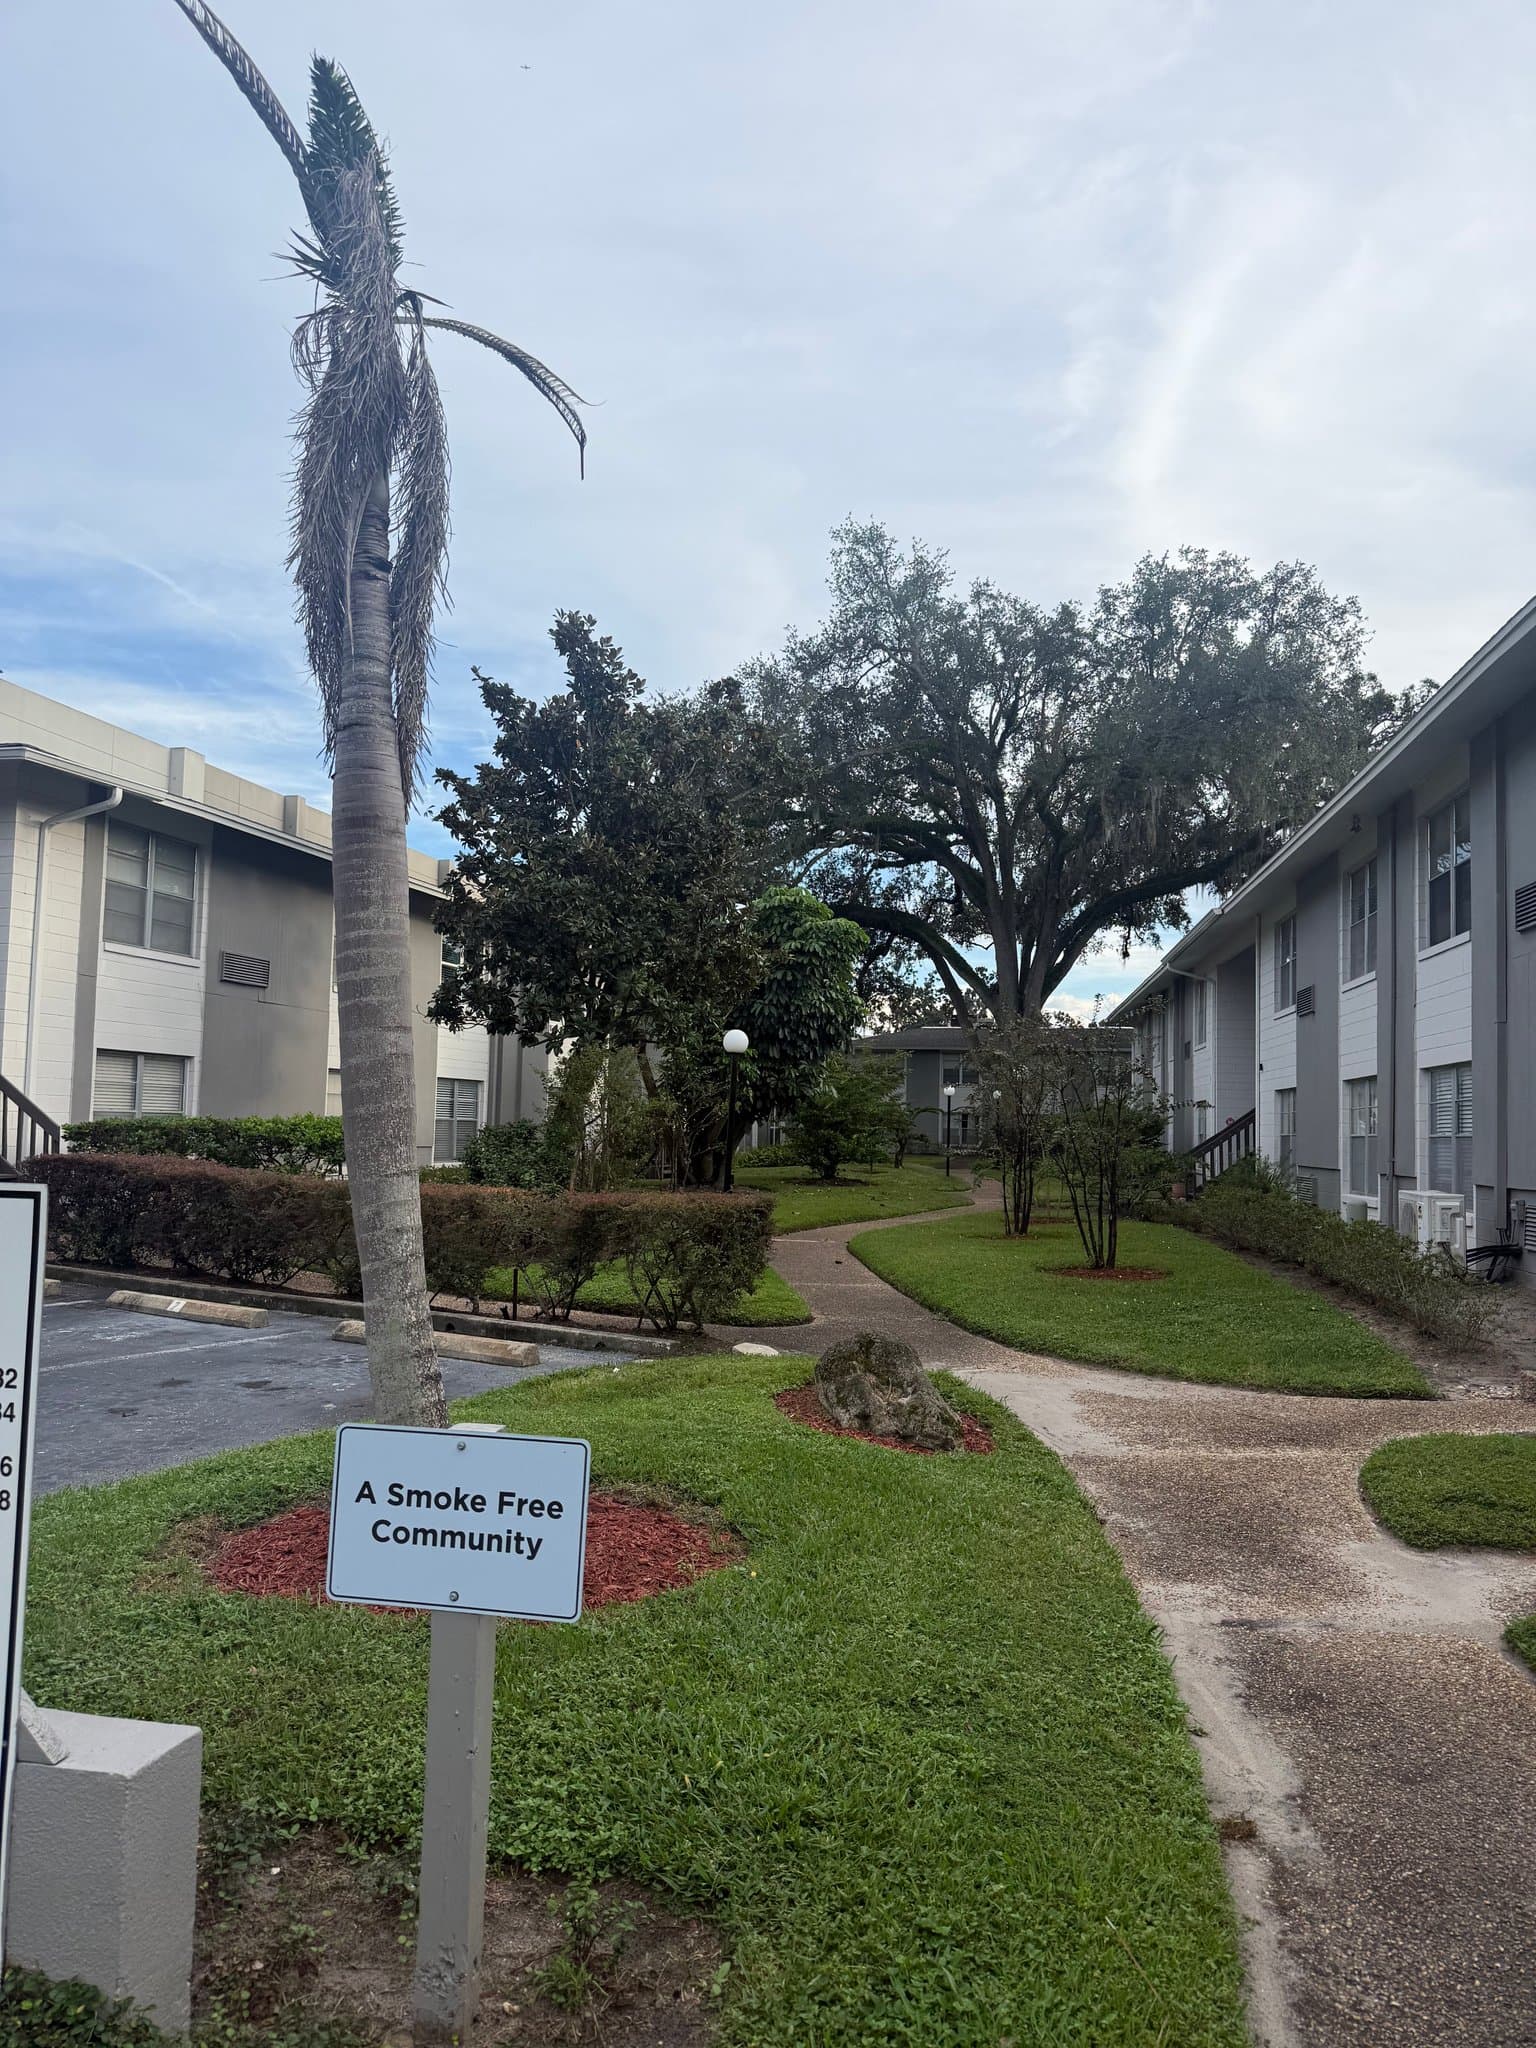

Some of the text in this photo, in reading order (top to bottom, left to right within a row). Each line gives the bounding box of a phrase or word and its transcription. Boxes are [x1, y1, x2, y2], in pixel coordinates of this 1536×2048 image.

[0, 1402, 16, 1423] 4
[0, 1455, 13, 1477] 6
[0, 1489, 11, 1511] 8
[354, 1480, 564, 1520] A Smoke Free
[371, 1519, 543, 1560] Community
